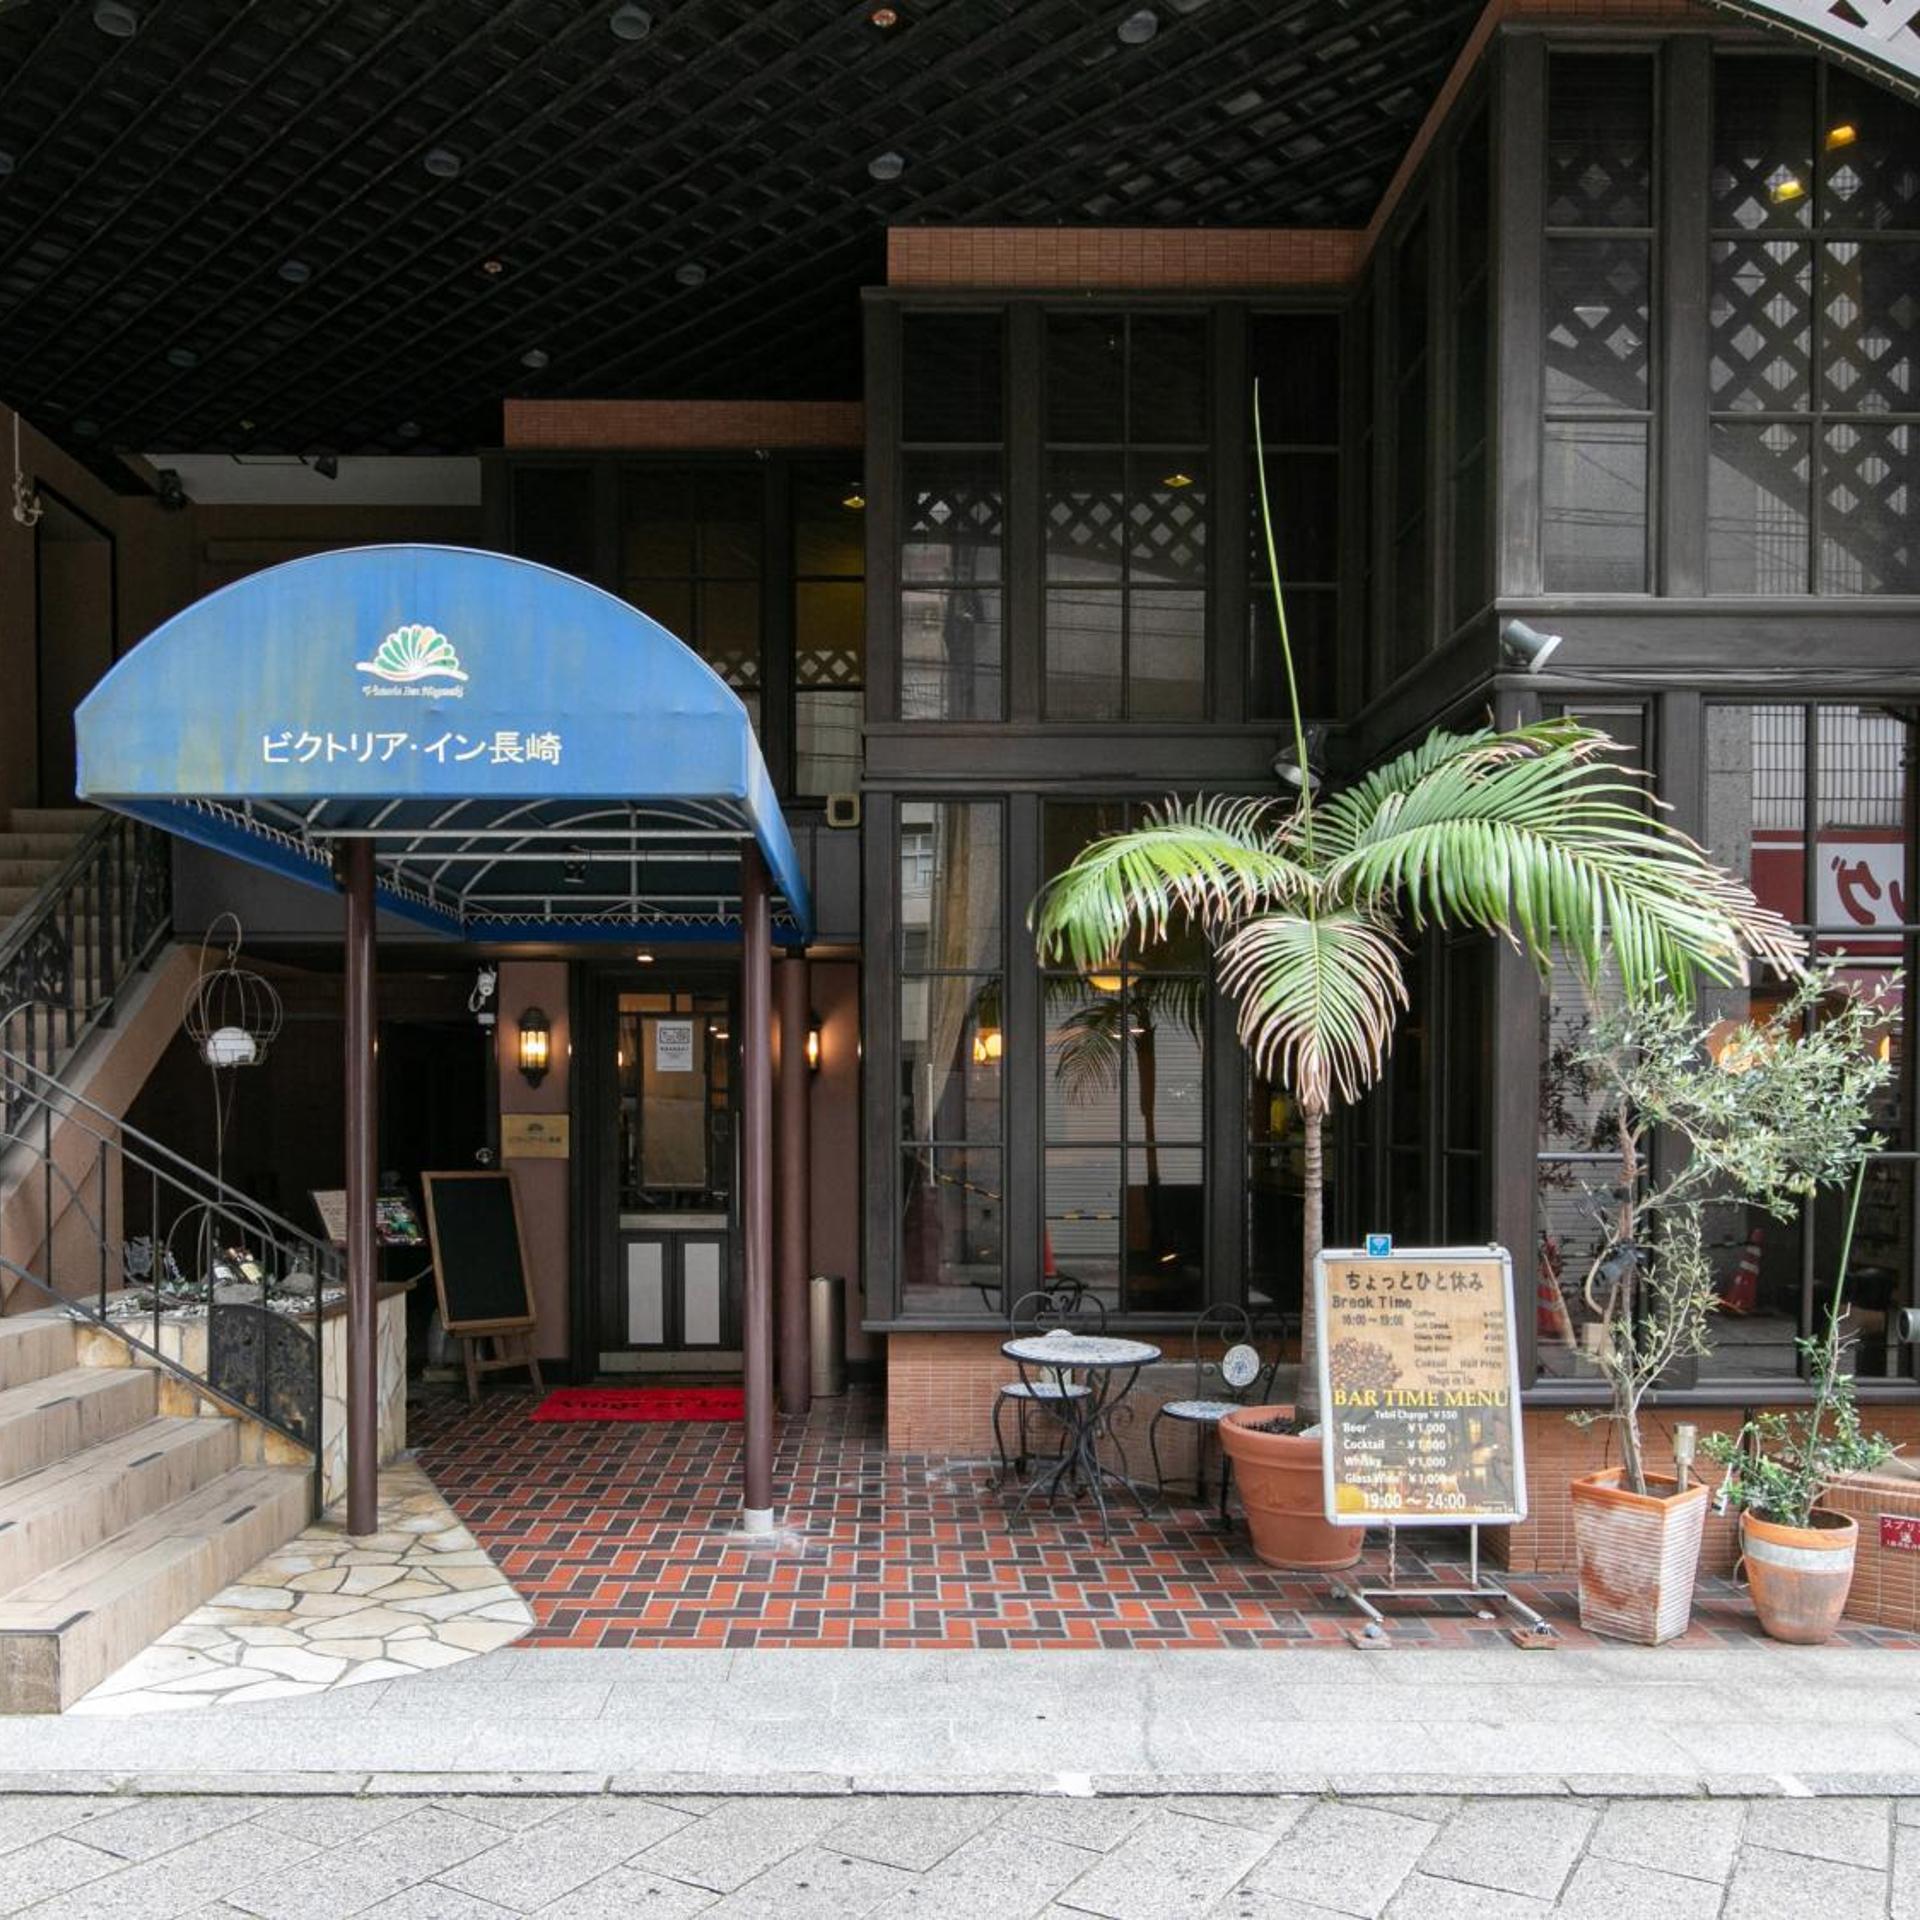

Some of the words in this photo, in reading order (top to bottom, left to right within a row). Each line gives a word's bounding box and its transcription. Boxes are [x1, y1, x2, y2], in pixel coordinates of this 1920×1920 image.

[1346, 1271, 1484, 1292] ちょっとひと休み
[1332, 1295, 1374, 1309] Break
[1378, 1295, 1412, 1309] Time
[1334, 1389, 1379, 1407] BAR
[1383, 1389, 1439, 1407] TIME
[1444, 1389, 1508, 1407] MENU
[1342, 1422, 1368, 1433] Beer
[1344, 1439, 1386, 1450] Cocktail
[1426, 1492, 1466, 1509] 24:00
